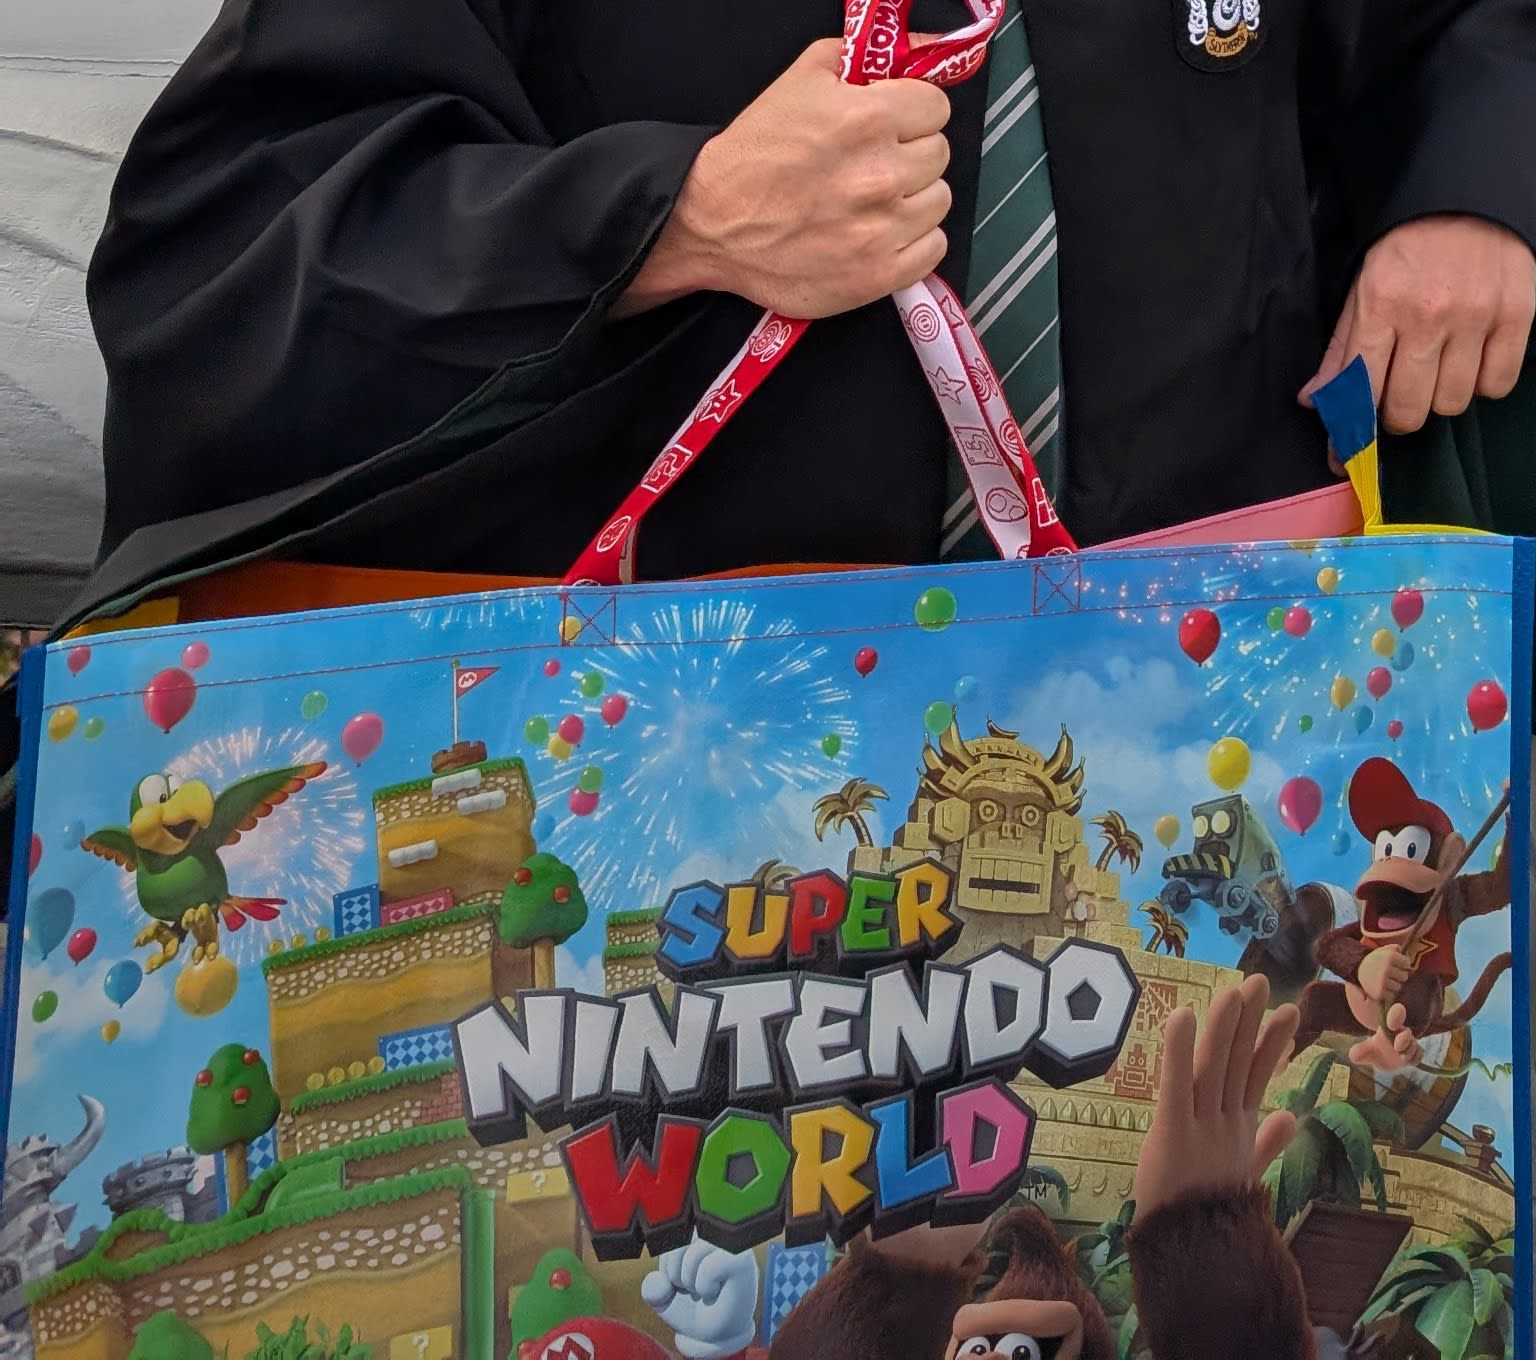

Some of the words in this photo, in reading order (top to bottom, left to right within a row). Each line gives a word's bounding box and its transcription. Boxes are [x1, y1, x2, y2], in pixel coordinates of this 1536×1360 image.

[659, 861, 956, 969] SUPER
[458, 944, 1133, 1120] NINTENDO
[564, 1082, 1031, 1232] WORLD
[1020, 1182, 1048, 1201] TM
